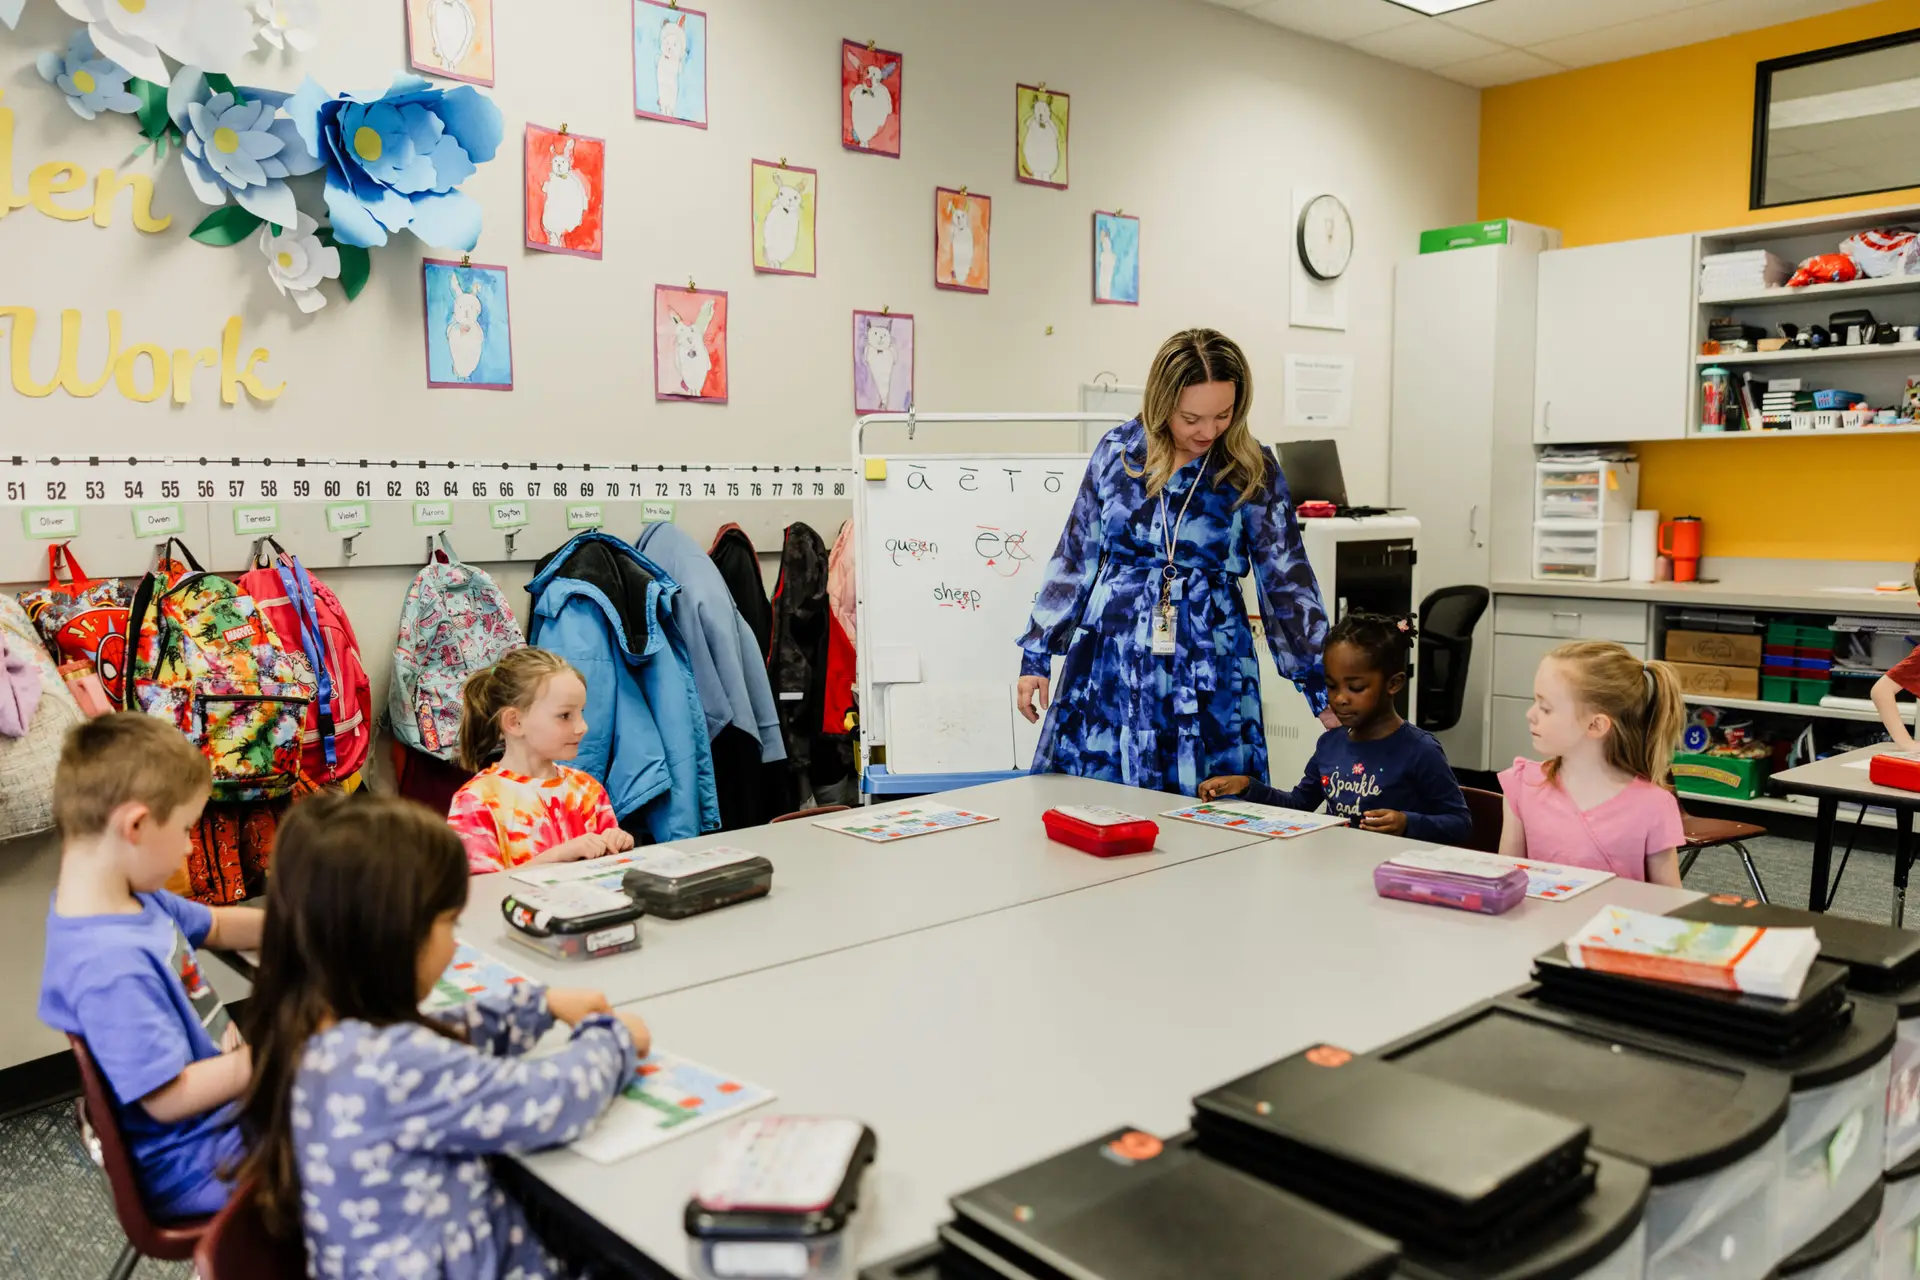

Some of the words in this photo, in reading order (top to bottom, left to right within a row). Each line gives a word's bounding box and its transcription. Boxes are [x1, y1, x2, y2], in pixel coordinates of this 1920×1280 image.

[0, 306, 286, 404] Work
[7, 482, 25, 500] 51
[47, 481, 67, 500] 52
[86, 480, 105, 500] 53
[124, 480, 144, 499] 54
[161, 480, 180, 498] 55
[197, 480, 215, 498] 56
[229, 480, 245, 498] 57
[260, 480, 278, 497] 58
[293, 480, 310, 497] 59
[324, 480, 341, 497] 60
[356, 480, 371, 497] 61
[387, 480, 402, 497] 62
[415, 480, 430, 497] 63
[443, 481, 459, 497] 64
[472, 481, 487, 497] 65
[499, 481, 514, 497] 66
[527, 482, 541, 497] 67
[553, 482, 568, 497] 68
[580, 482, 594, 497] 69
[606, 482, 620, 497] 70
[629, 483, 641, 497] 71
[655, 482, 668, 497] 72
[678, 482, 692, 497] 73
[703, 483, 716, 496] 74
[727, 483, 739, 497] 75
[750, 483, 762, 497] 76
[772, 483, 783, 496] 77
[792, 482, 803, 496] 78
[812, 482, 824, 496] 79
[833, 482, 845, 496] 80
[337, 510, 359, 520] Violet
[421, 507, 445, 517] Aurora
[497, 507, 521, 519] Dayton
[39, 516, 65, 526] Oliver
[147, 515, 171, 525] Owen
[244, 514, 271, 523] Teresa
[933, 582, 981, 611] sheep
[1328, 771, 1382, 800] Sparkle
[1336, 796, 1362, 816] and
